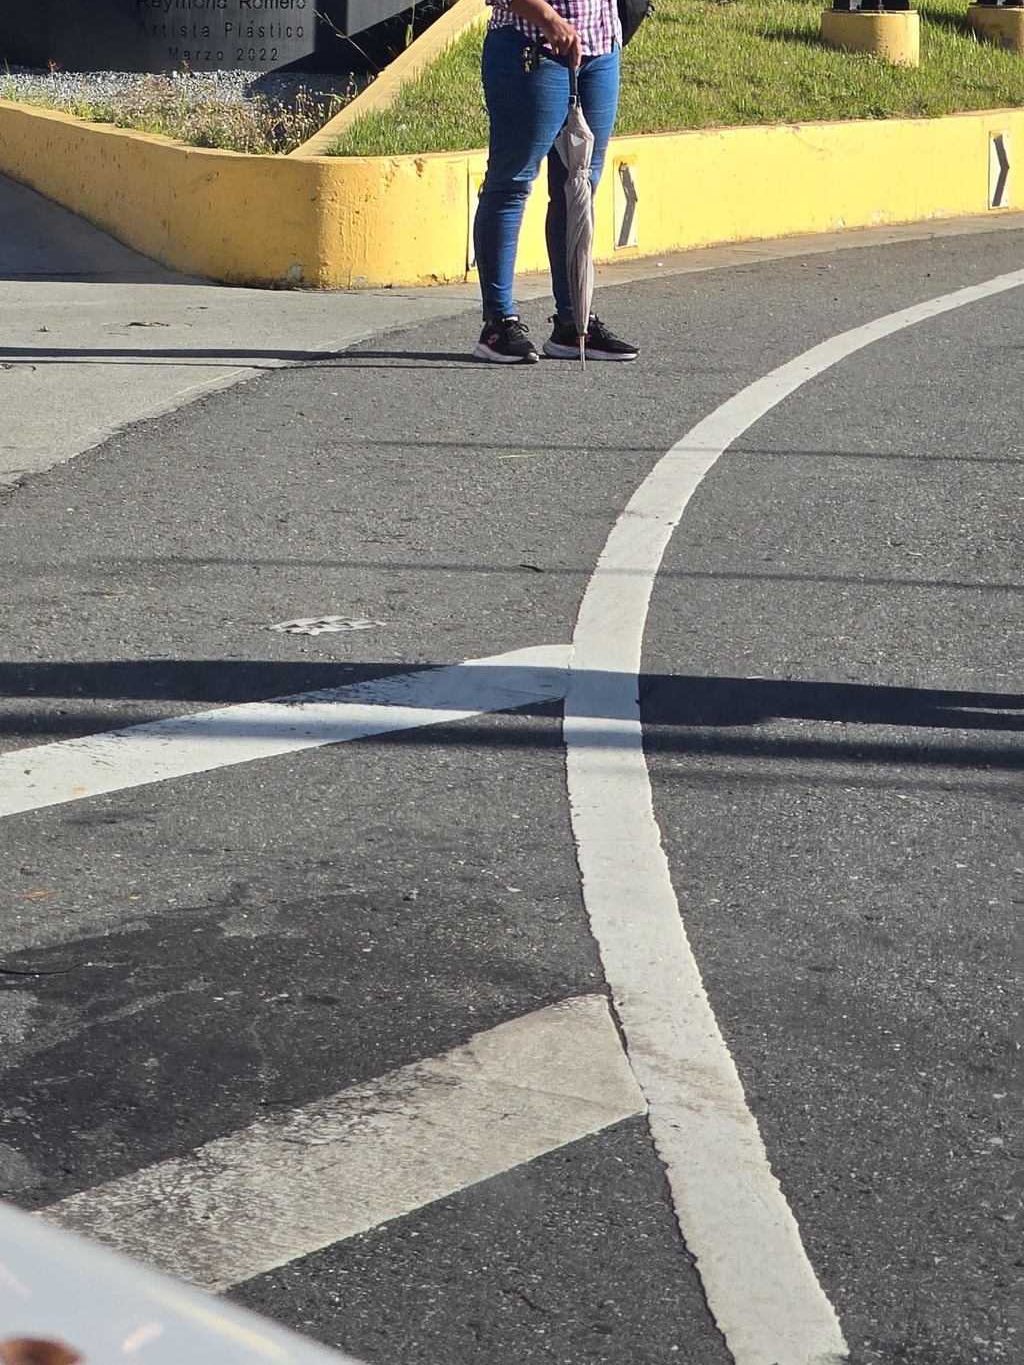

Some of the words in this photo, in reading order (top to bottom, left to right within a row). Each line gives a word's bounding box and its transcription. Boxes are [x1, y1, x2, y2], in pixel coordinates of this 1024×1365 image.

[139, 21, 210, 37] Artista
[225, 21, 304, 38] Plástico
[168, 47, 224, 60] Marzo
[237, 48, 278, 61] 2022
